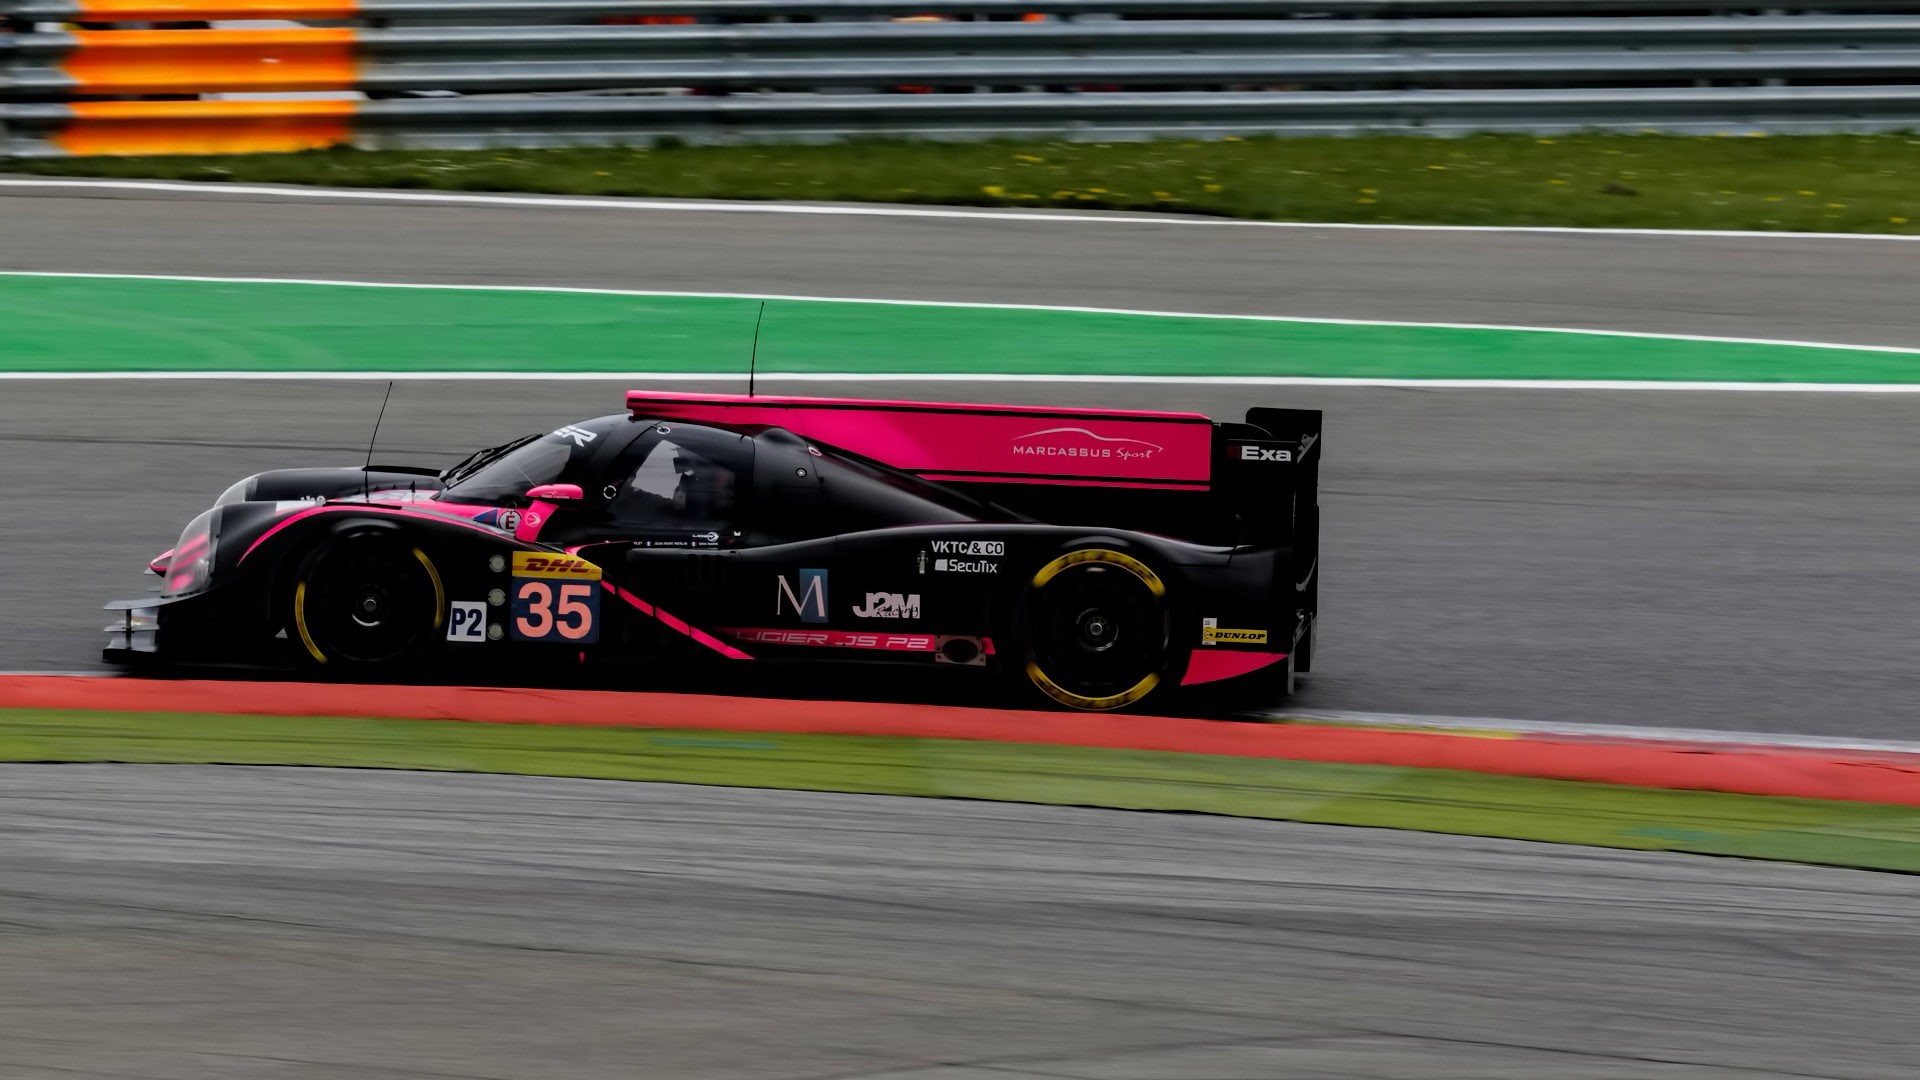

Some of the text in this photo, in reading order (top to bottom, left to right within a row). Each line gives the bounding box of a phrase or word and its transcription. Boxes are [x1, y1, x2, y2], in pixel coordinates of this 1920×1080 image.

[1013, 445, 1153, 460] MARCASSUS Sport
[1241, 445, 1292, 462] Exa
[931, 540, 968, 554] VKTC
[985, 543, 1003, 554] CO
[525, 558, 590, 573] DHL
[949, 559, 998, 573] SecuTix
[777, 575, 826, 617] M
[516, 581, 593, 640] 35
[852, 592, 921, 619] J2M
[450, 607, 483, 637] P2
[736, 631, 930, 649] LIGIER JS P2
[1215, 632, 1266, 640] DUNLOP
